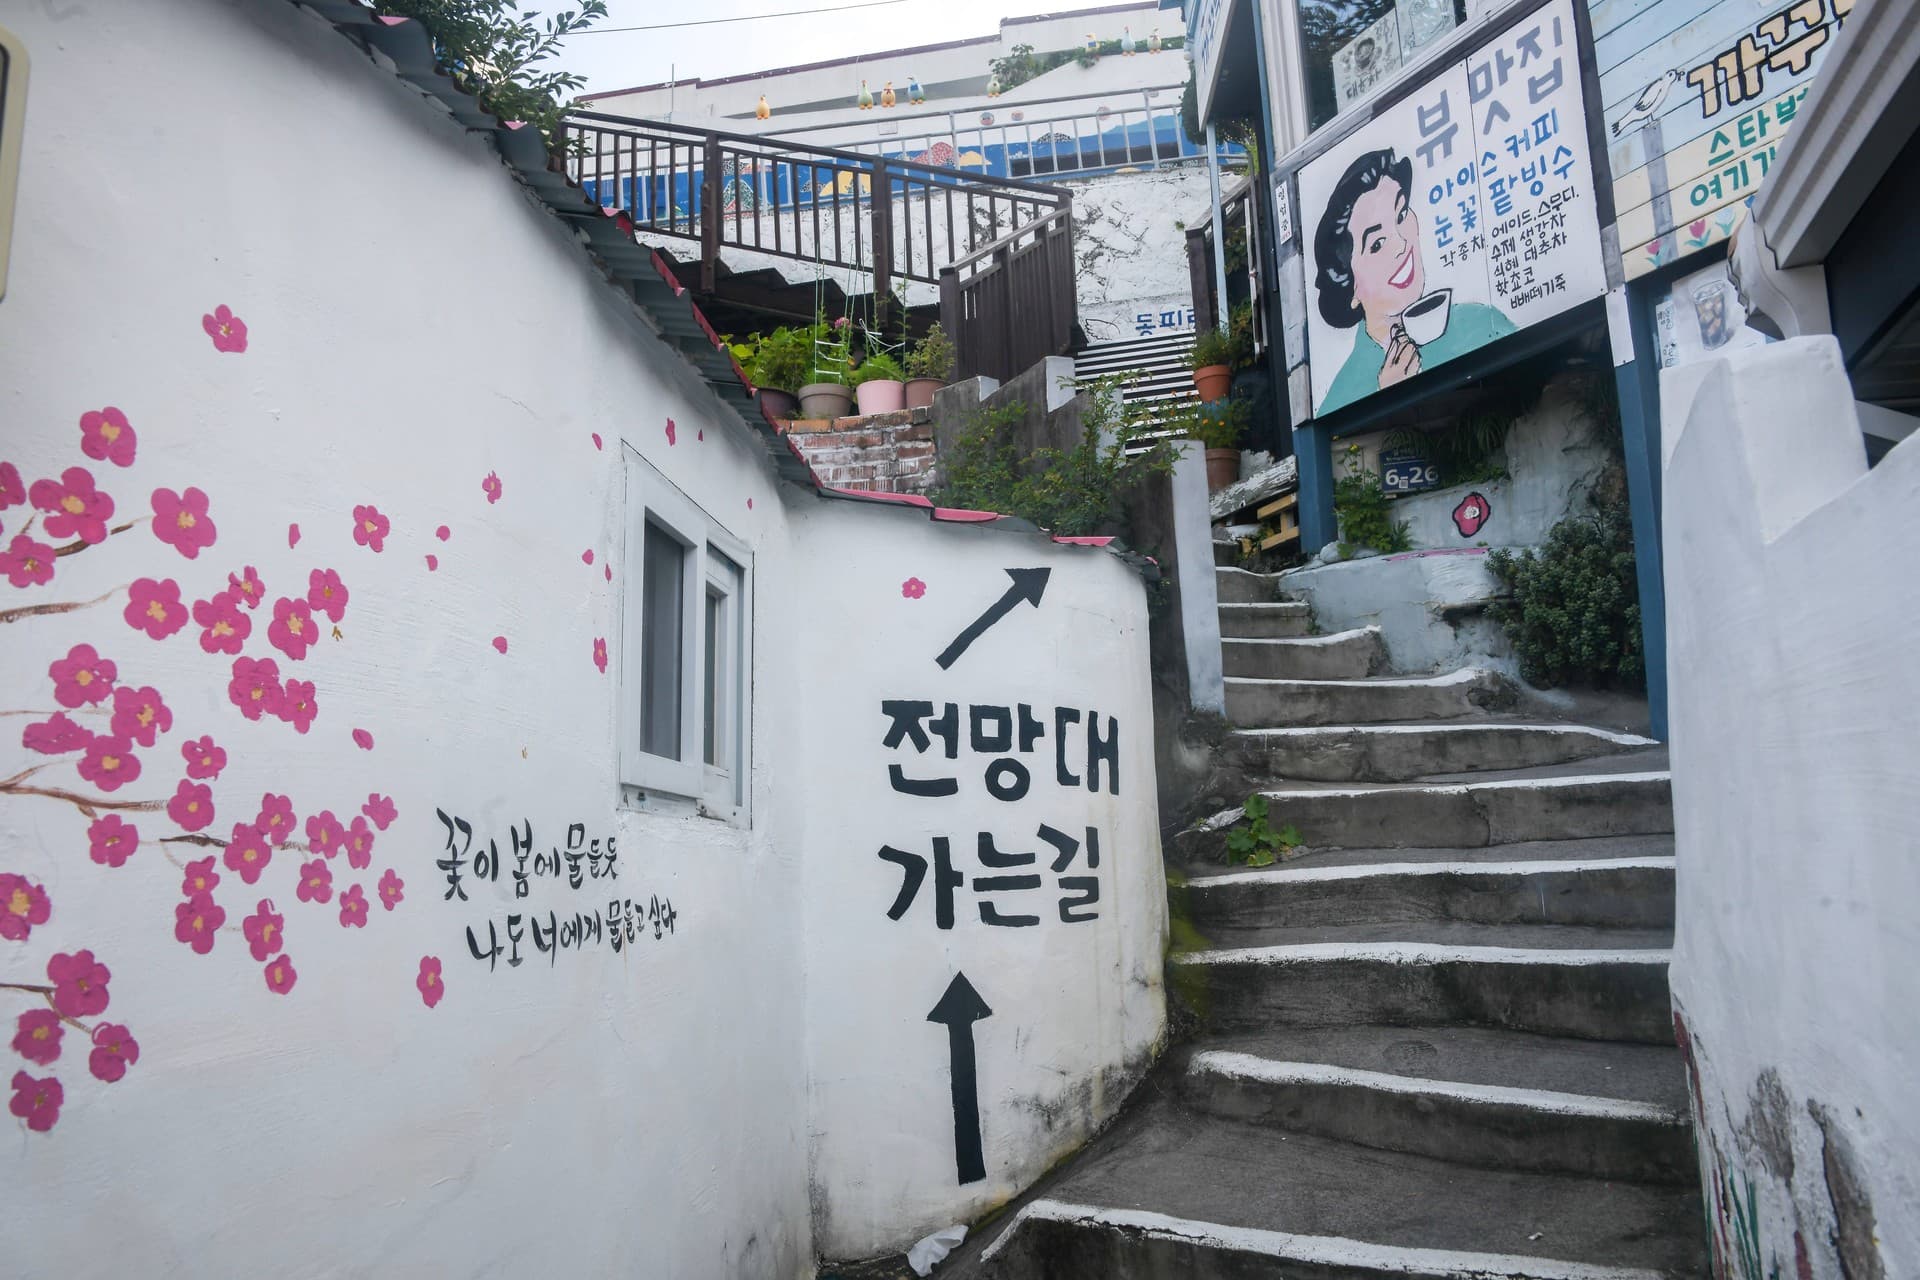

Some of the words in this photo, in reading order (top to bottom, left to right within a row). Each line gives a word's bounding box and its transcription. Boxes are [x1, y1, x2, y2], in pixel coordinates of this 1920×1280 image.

[1429, 151, 1498, 205] 아이스
[1504, 107, 1560, 158] 커피
[1488, 145, 1576, 217] 팥빙수
[1490, 236, 1516, 263] 수제
[1519, 212, 1567, 247] 생강차
[1524, 231, 1568, 262] 대추차
[1385, 465, 1439, 486] 6-26
[882, 699, 1119, 802] 전망대
[436, 807, 499, 901] 꽃이
[510, 817, 561, 900] 봄에
[466, 914, 524, 973] 나도
[531, 908, 602, 968] 너에게
